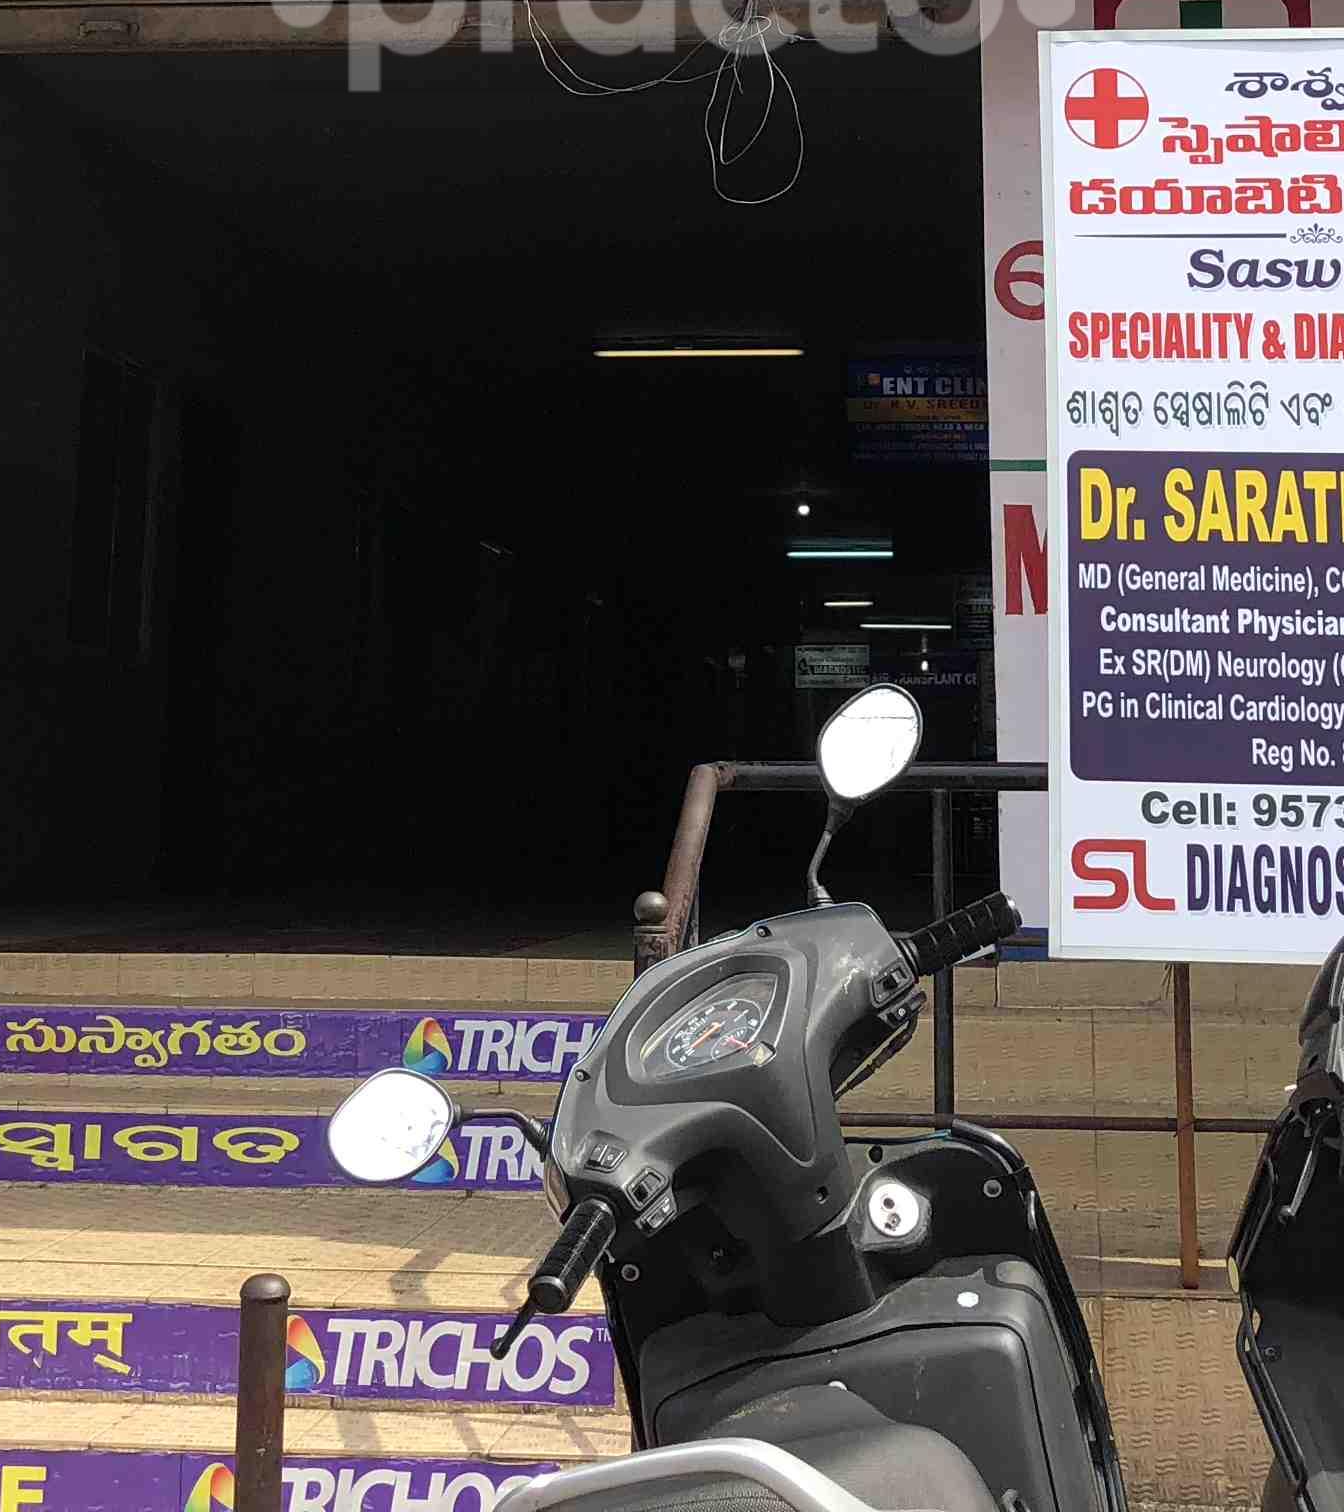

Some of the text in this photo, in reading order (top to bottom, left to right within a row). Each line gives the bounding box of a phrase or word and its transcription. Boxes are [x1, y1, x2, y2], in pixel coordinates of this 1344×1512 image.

[1068, 311, 1256, 362] SPECIALITY
[1261, 318, 1286, 361] &
[1078, 467, 1146, 543] Dr.
[1077, 564, 1111, 590] MD
[1117, 565, 1209, 597] (General
[1212, 566, 1320, 601] Medicine),
[1099, 605, 1230, 636] Consultant
[1251, 738, 1294, 773] Reg
[1299, 739, 1336, 768] No.
[1140, 790, 1237, 826] Cell:
[327, 1315, 593, 1395] TRICHOS
